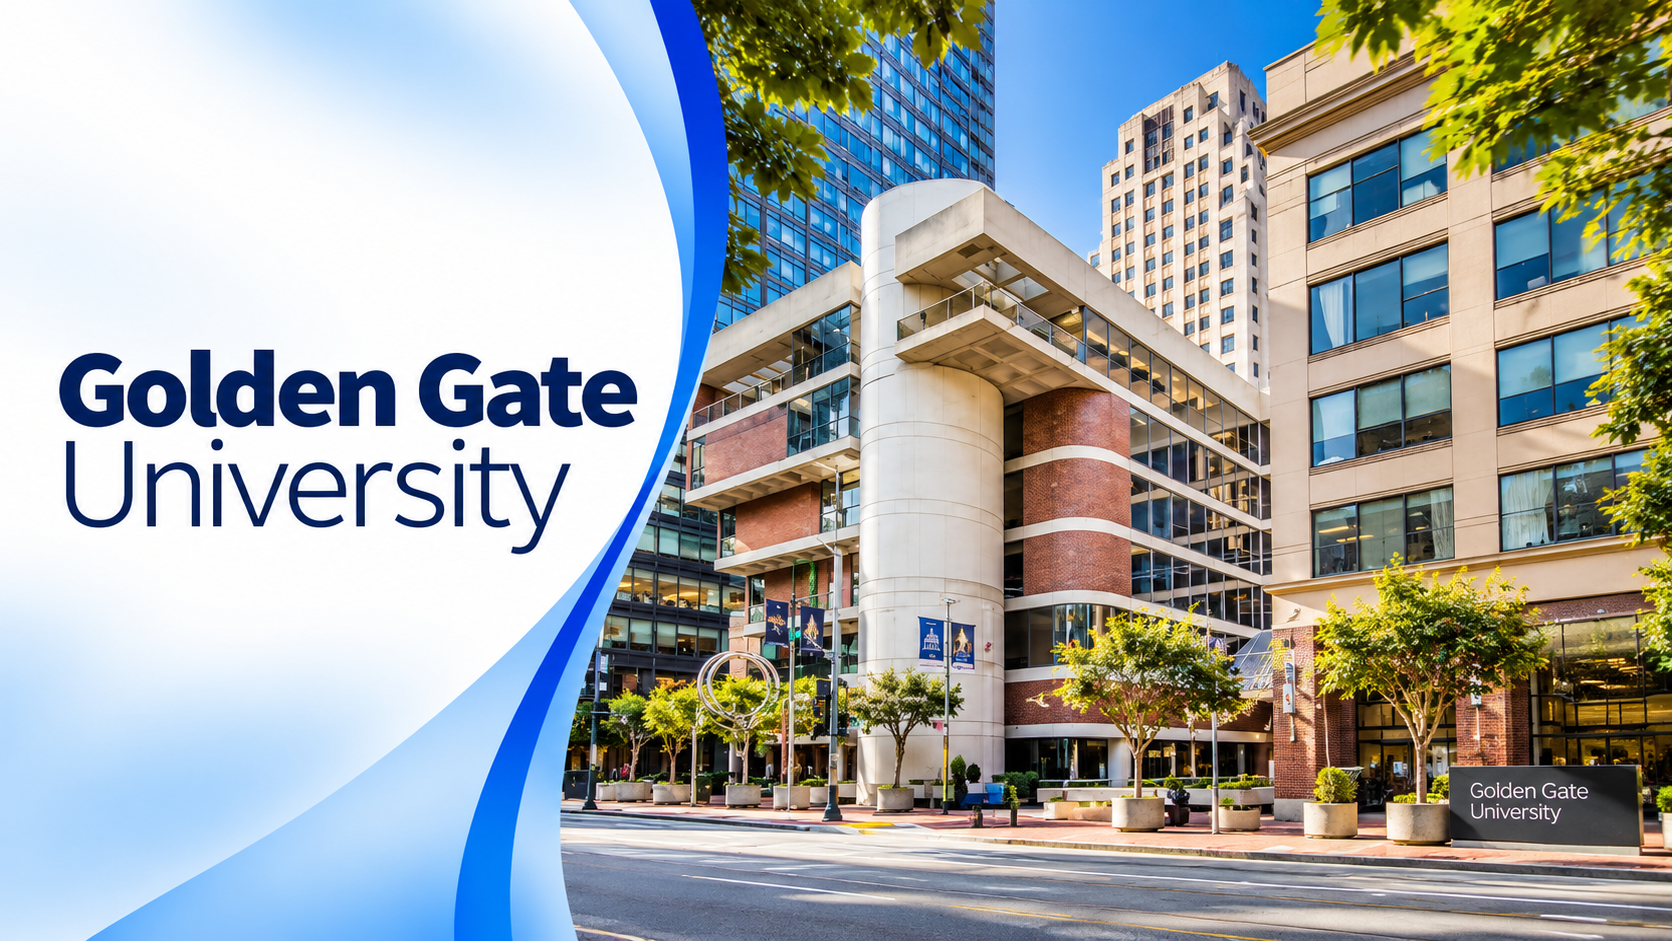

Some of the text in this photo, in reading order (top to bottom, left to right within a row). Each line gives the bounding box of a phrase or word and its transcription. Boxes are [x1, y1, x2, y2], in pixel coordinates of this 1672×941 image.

[1470, 781, 1589, 800] Golden Gate
[1470, 802, 1562, 825] University
